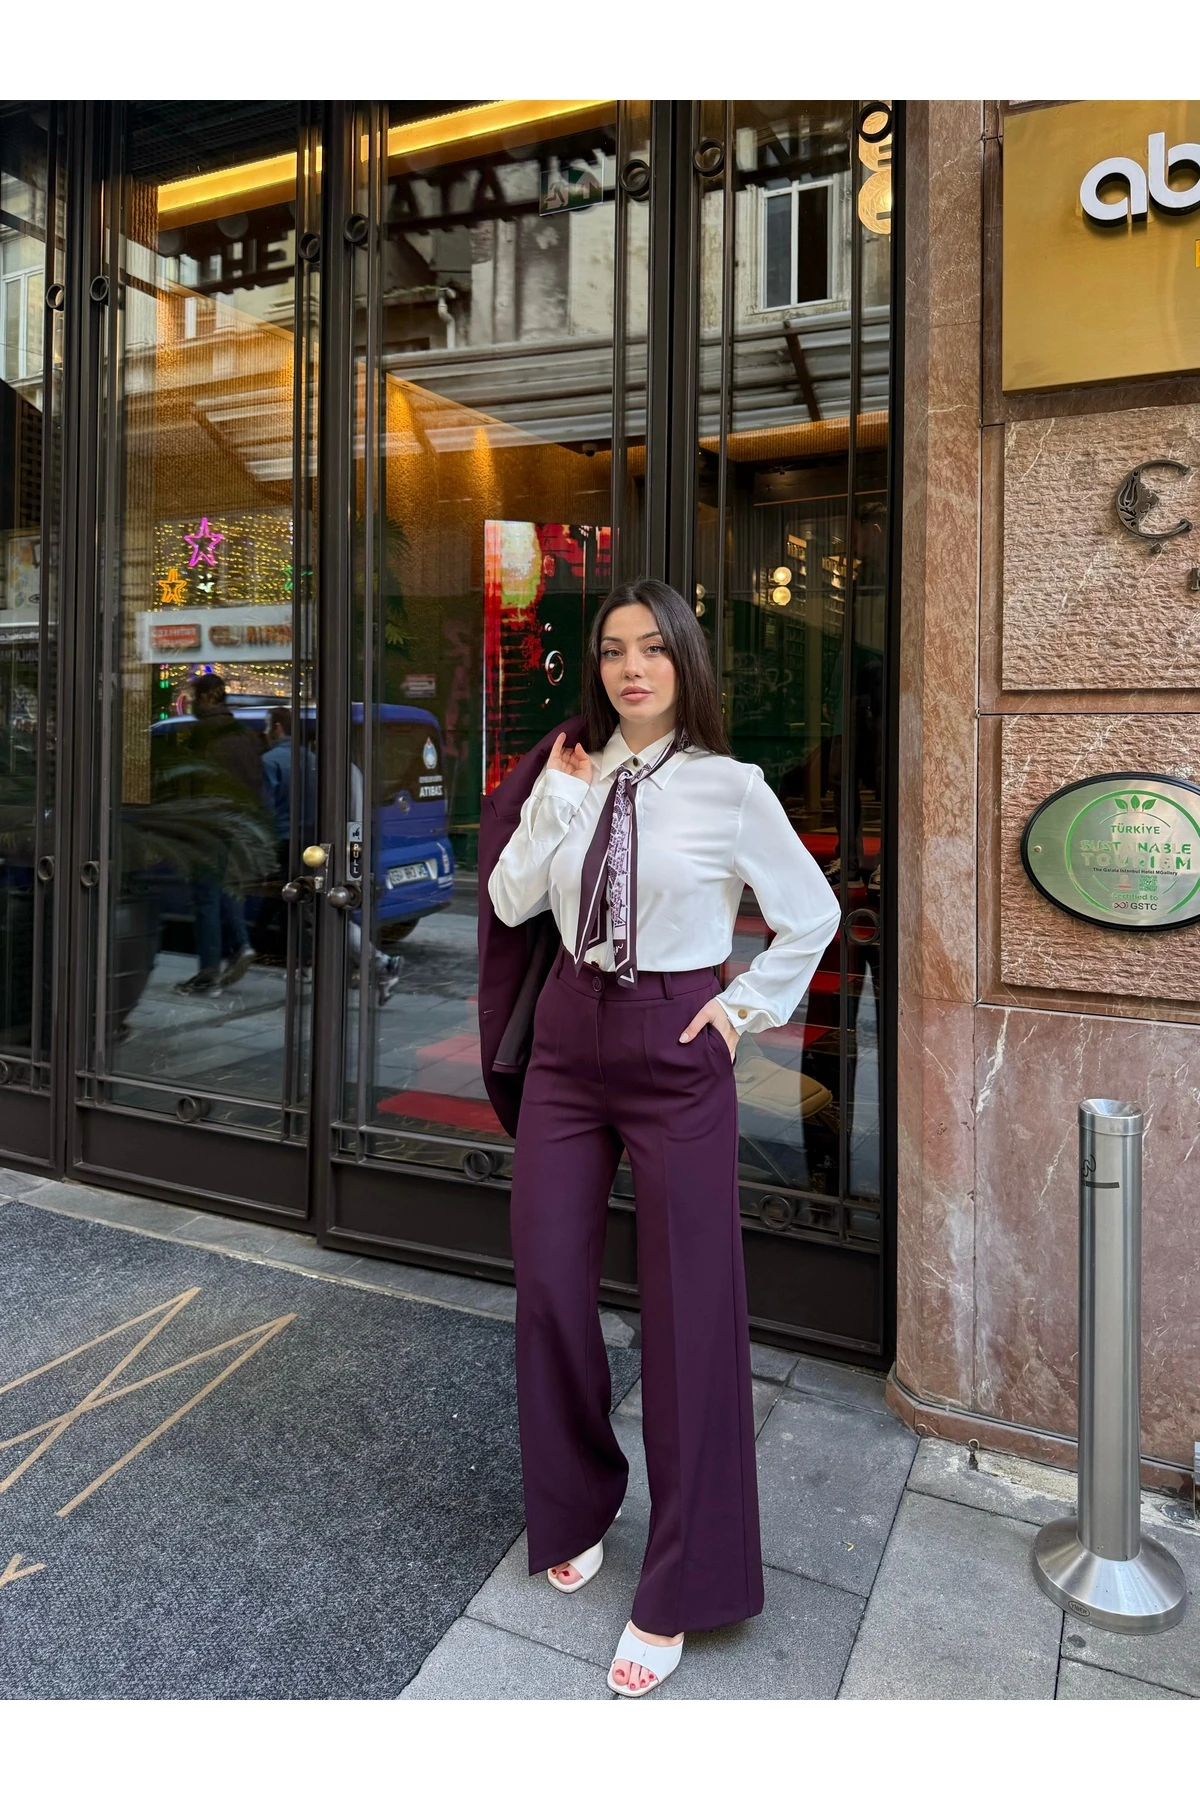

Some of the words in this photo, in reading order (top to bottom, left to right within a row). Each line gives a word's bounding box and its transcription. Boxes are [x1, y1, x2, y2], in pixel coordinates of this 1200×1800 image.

[1110, 823, 1160, 834] TÜRKİYE
[1080, 839, 1191, 854] SUSTNABLE
[353, 843, 361, 874] PULL
[1080, 853, 1191, 870] TOURIM
[1130, 902, 1158, 911] GSTC
